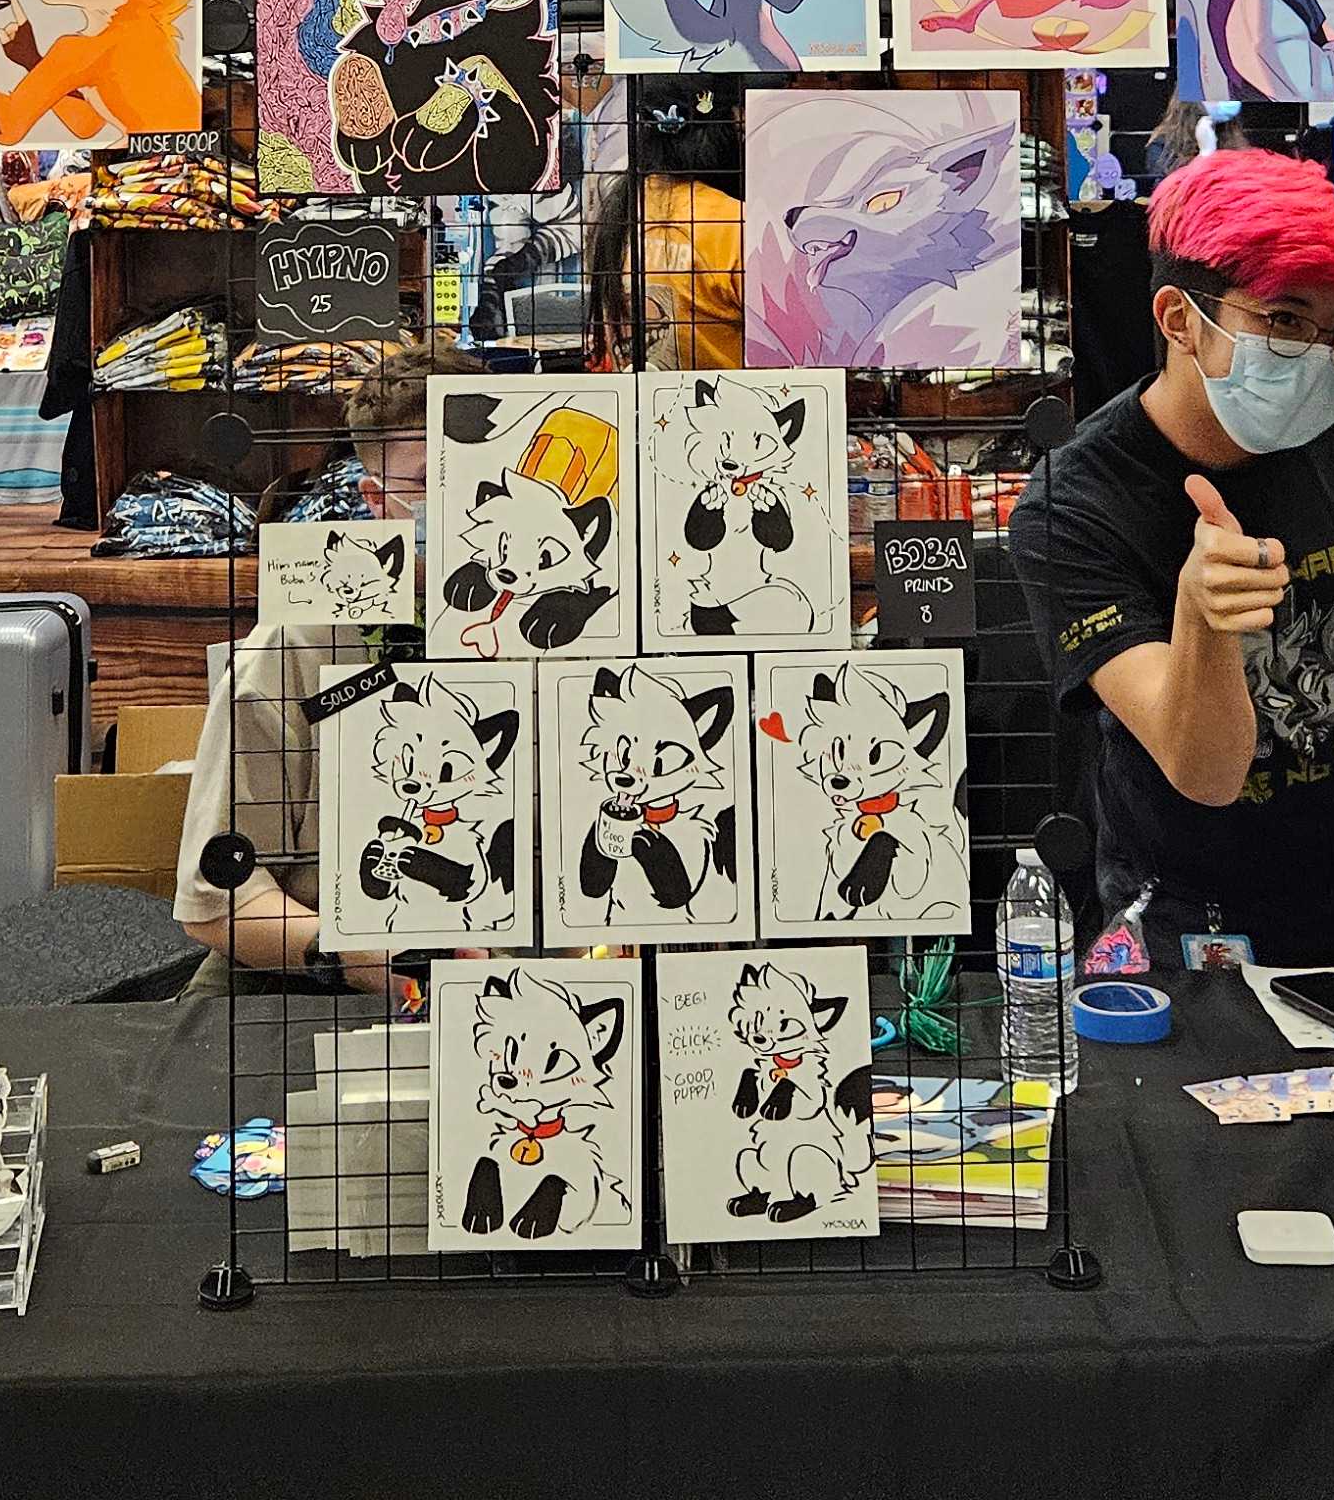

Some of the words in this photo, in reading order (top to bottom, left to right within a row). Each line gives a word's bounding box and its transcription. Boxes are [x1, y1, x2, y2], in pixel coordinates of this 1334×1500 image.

[129, 134, 171, 155] NOSE
[175, 130, 219, 155] BOOP
[269, 243, 390, 292] HYPNO
[309, 294, 332, 315] 25
[884, 537, 968, 575] BOBA
[904, 576, 954, 593] PRINTS
[919, 604, 933, 624] 8
[320, 687, 356, 712] SOLD
[359, 669, 387, 692] OUT
[674, 991, 707, 1011] BEG!
[672, 1033, 714, 1050] CLICK
[674, 1068, 714, 1087] GOOD
[673, 1080, 716, 1106] PUPPY!
